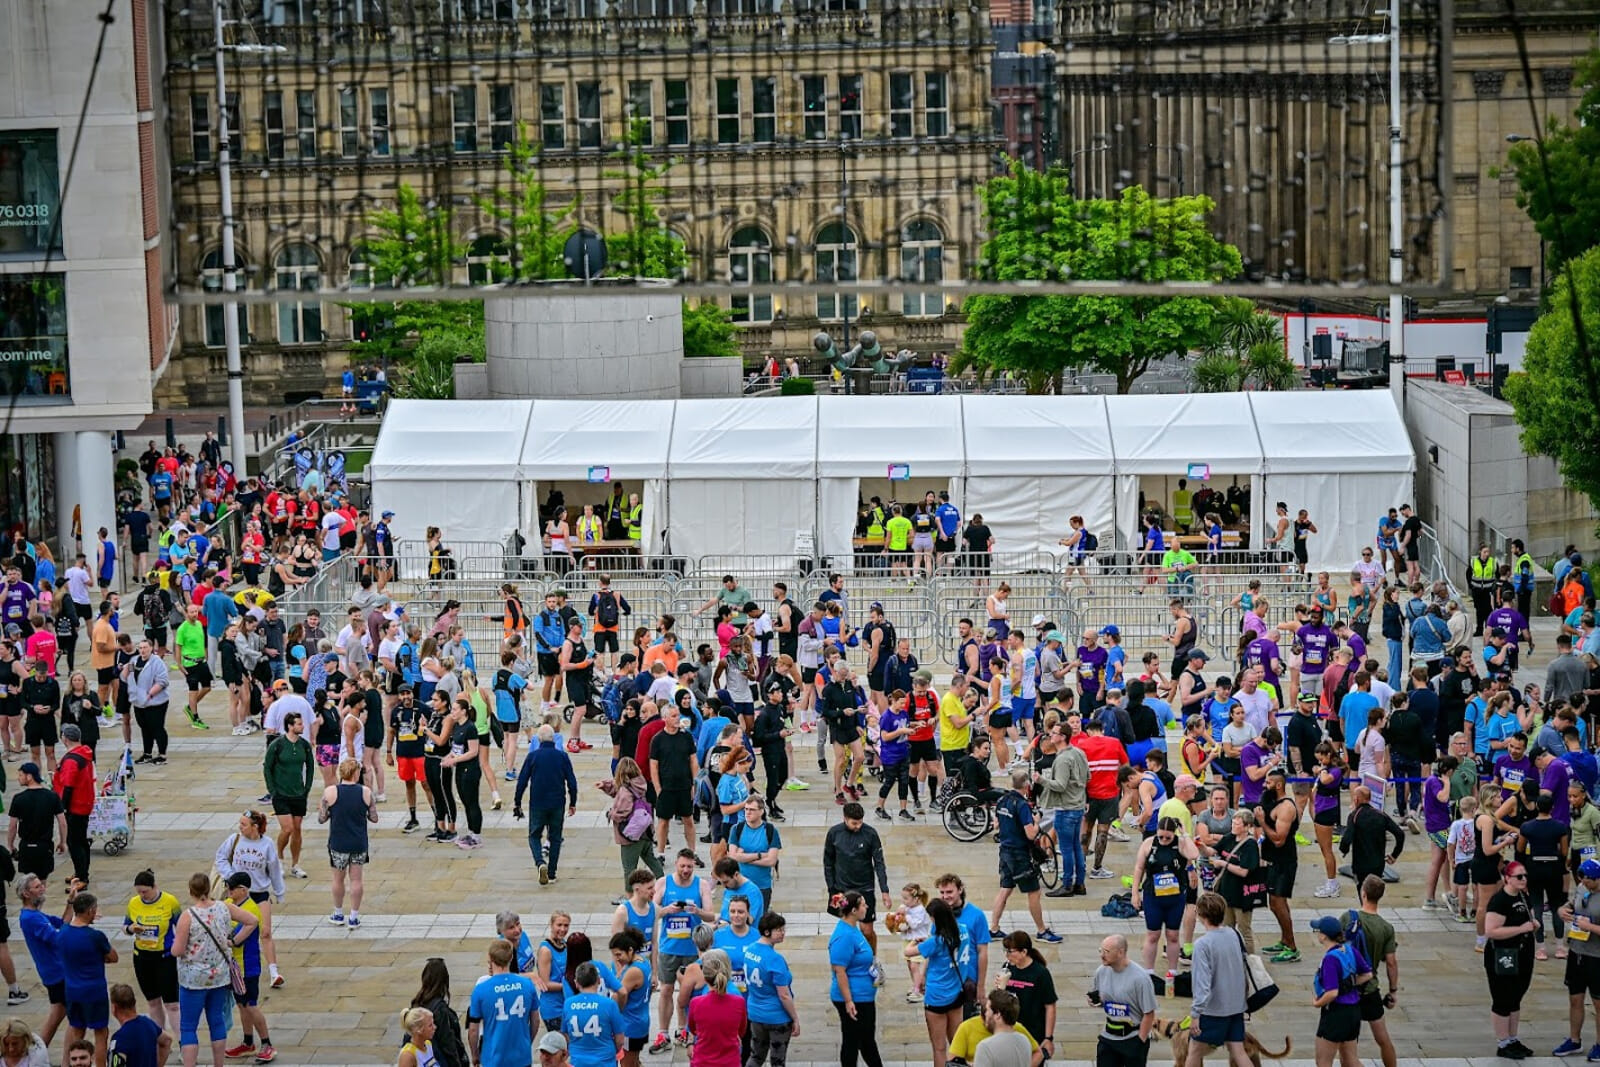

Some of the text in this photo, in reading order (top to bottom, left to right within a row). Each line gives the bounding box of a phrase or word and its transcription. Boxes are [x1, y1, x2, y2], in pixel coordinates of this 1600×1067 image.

[16, 204, 49, 217] 0318
[494, 982, 522, 993] OSCAR
[495, 994, 526, 1021] 14
[570, 1001, 599, 1010] OSCAR
[569, 1014, 603, 1038] 14
